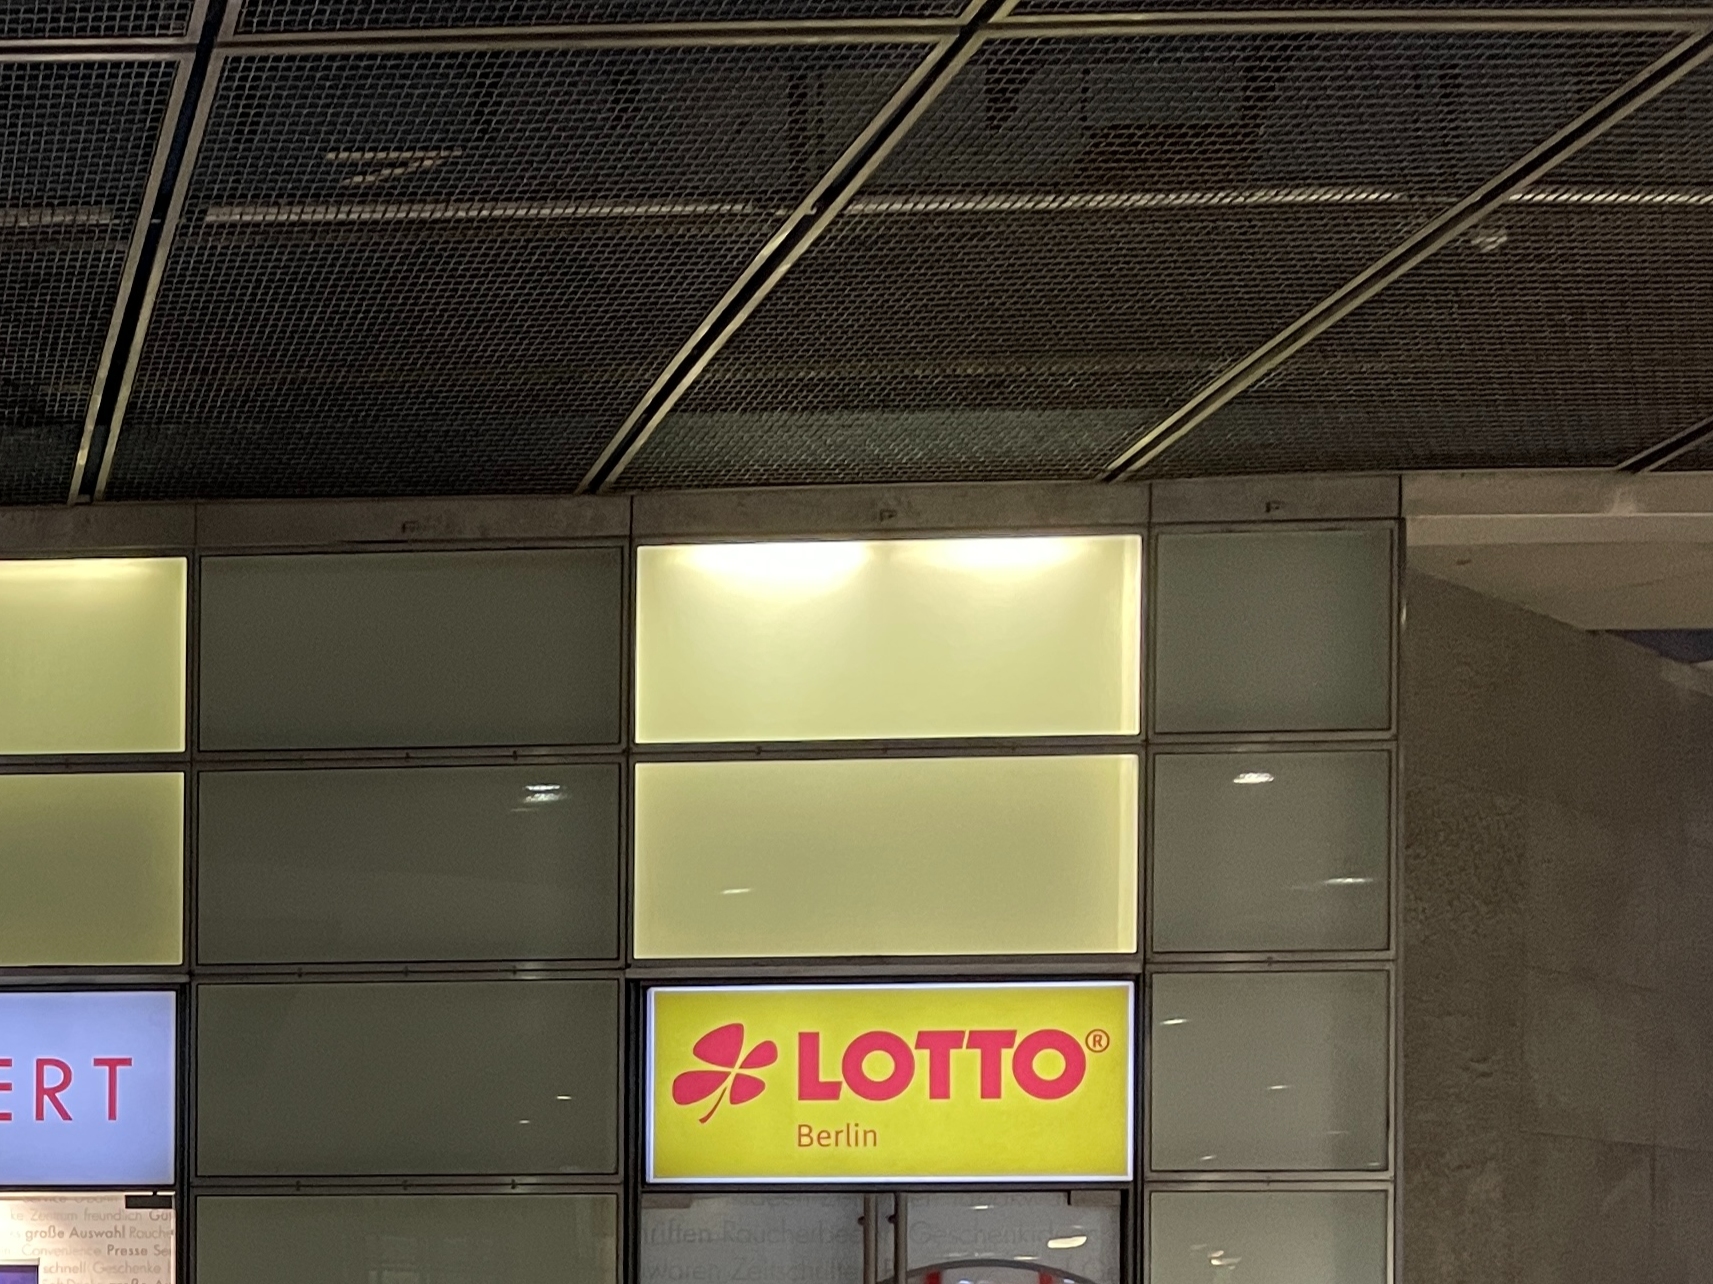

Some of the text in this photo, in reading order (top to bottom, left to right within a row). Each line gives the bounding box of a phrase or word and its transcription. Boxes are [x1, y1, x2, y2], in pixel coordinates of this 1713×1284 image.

[797, 1123, 878, 1148] Berlin
[25, 1225, 65, 1241] große
[69, 1226, 126, 1239] Auswahl
[107, 1244, 148, 1256] Presse
[43, 1261, 87, 1274] schnell
